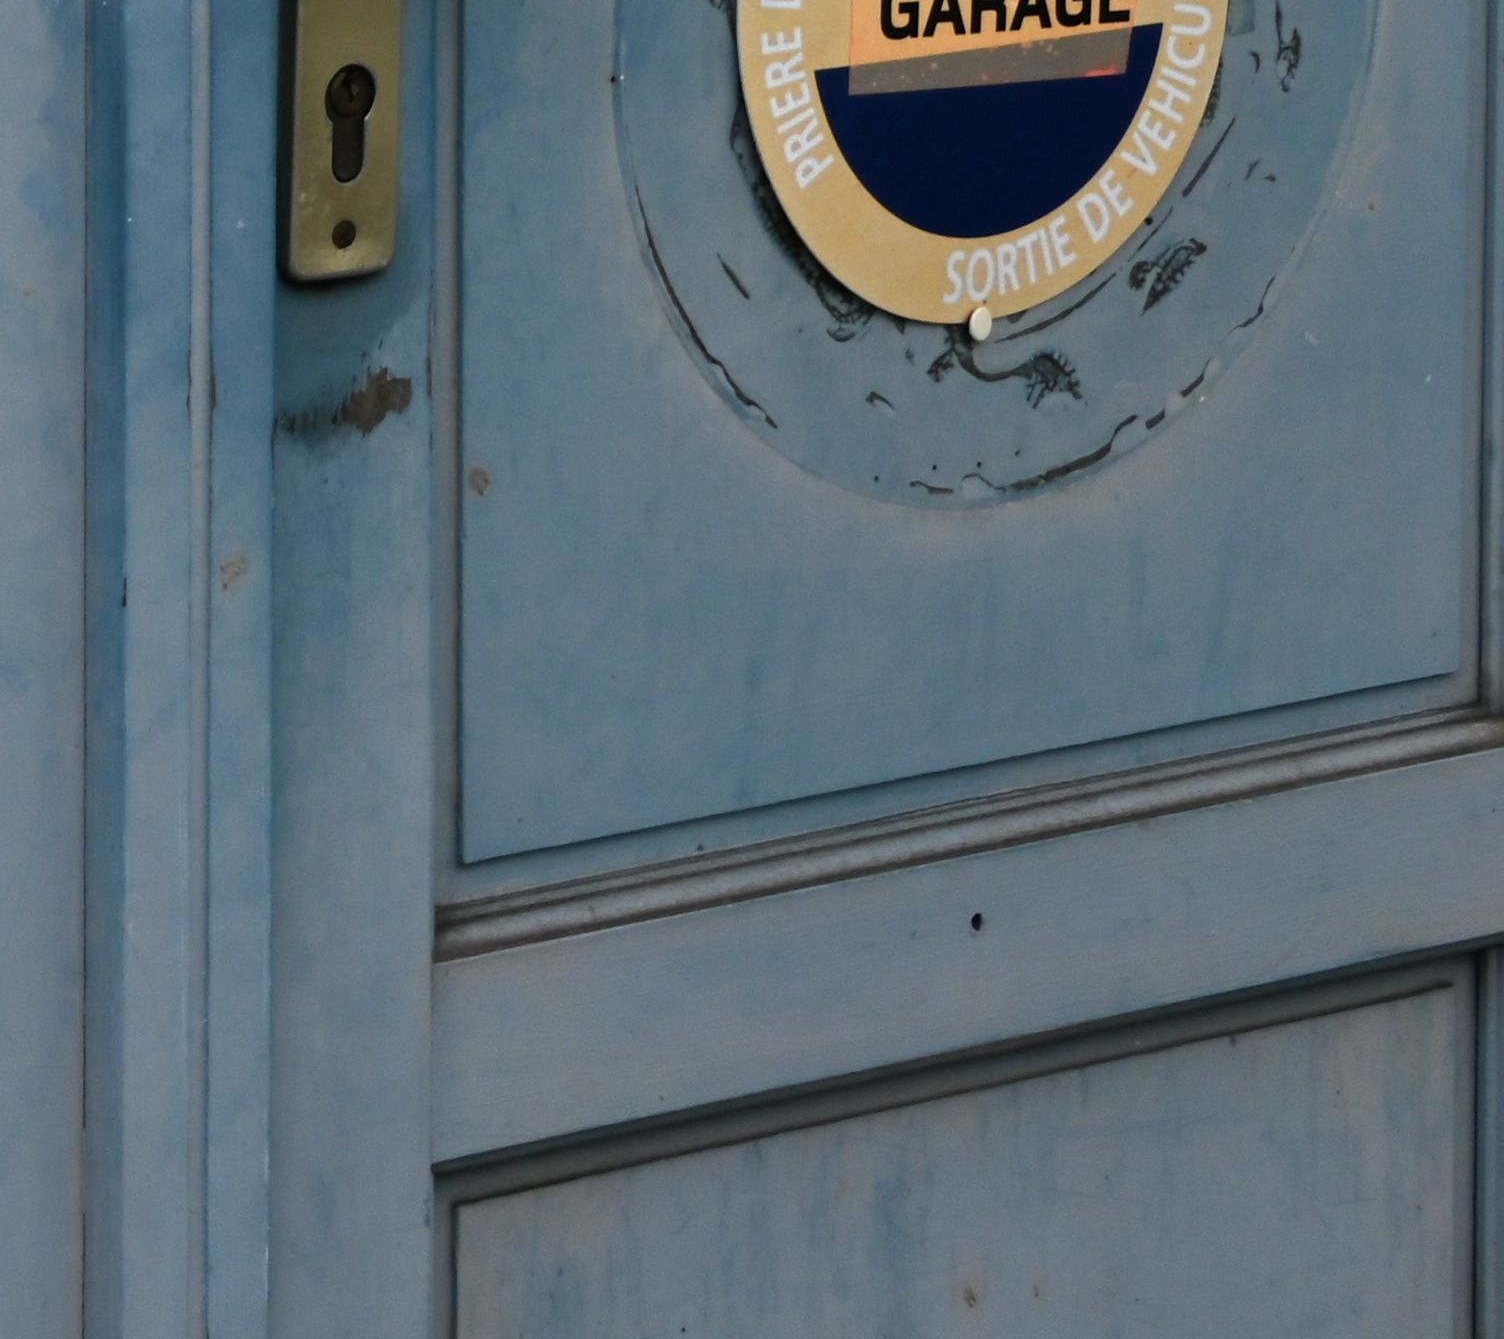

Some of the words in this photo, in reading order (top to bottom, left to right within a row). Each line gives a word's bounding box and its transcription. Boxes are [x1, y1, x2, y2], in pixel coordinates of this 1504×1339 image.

[758, 26, 835, 189] PRIERE
[941, 218, 1079, 308] SORTIE
[1076, 168, 1137, 244] DE
